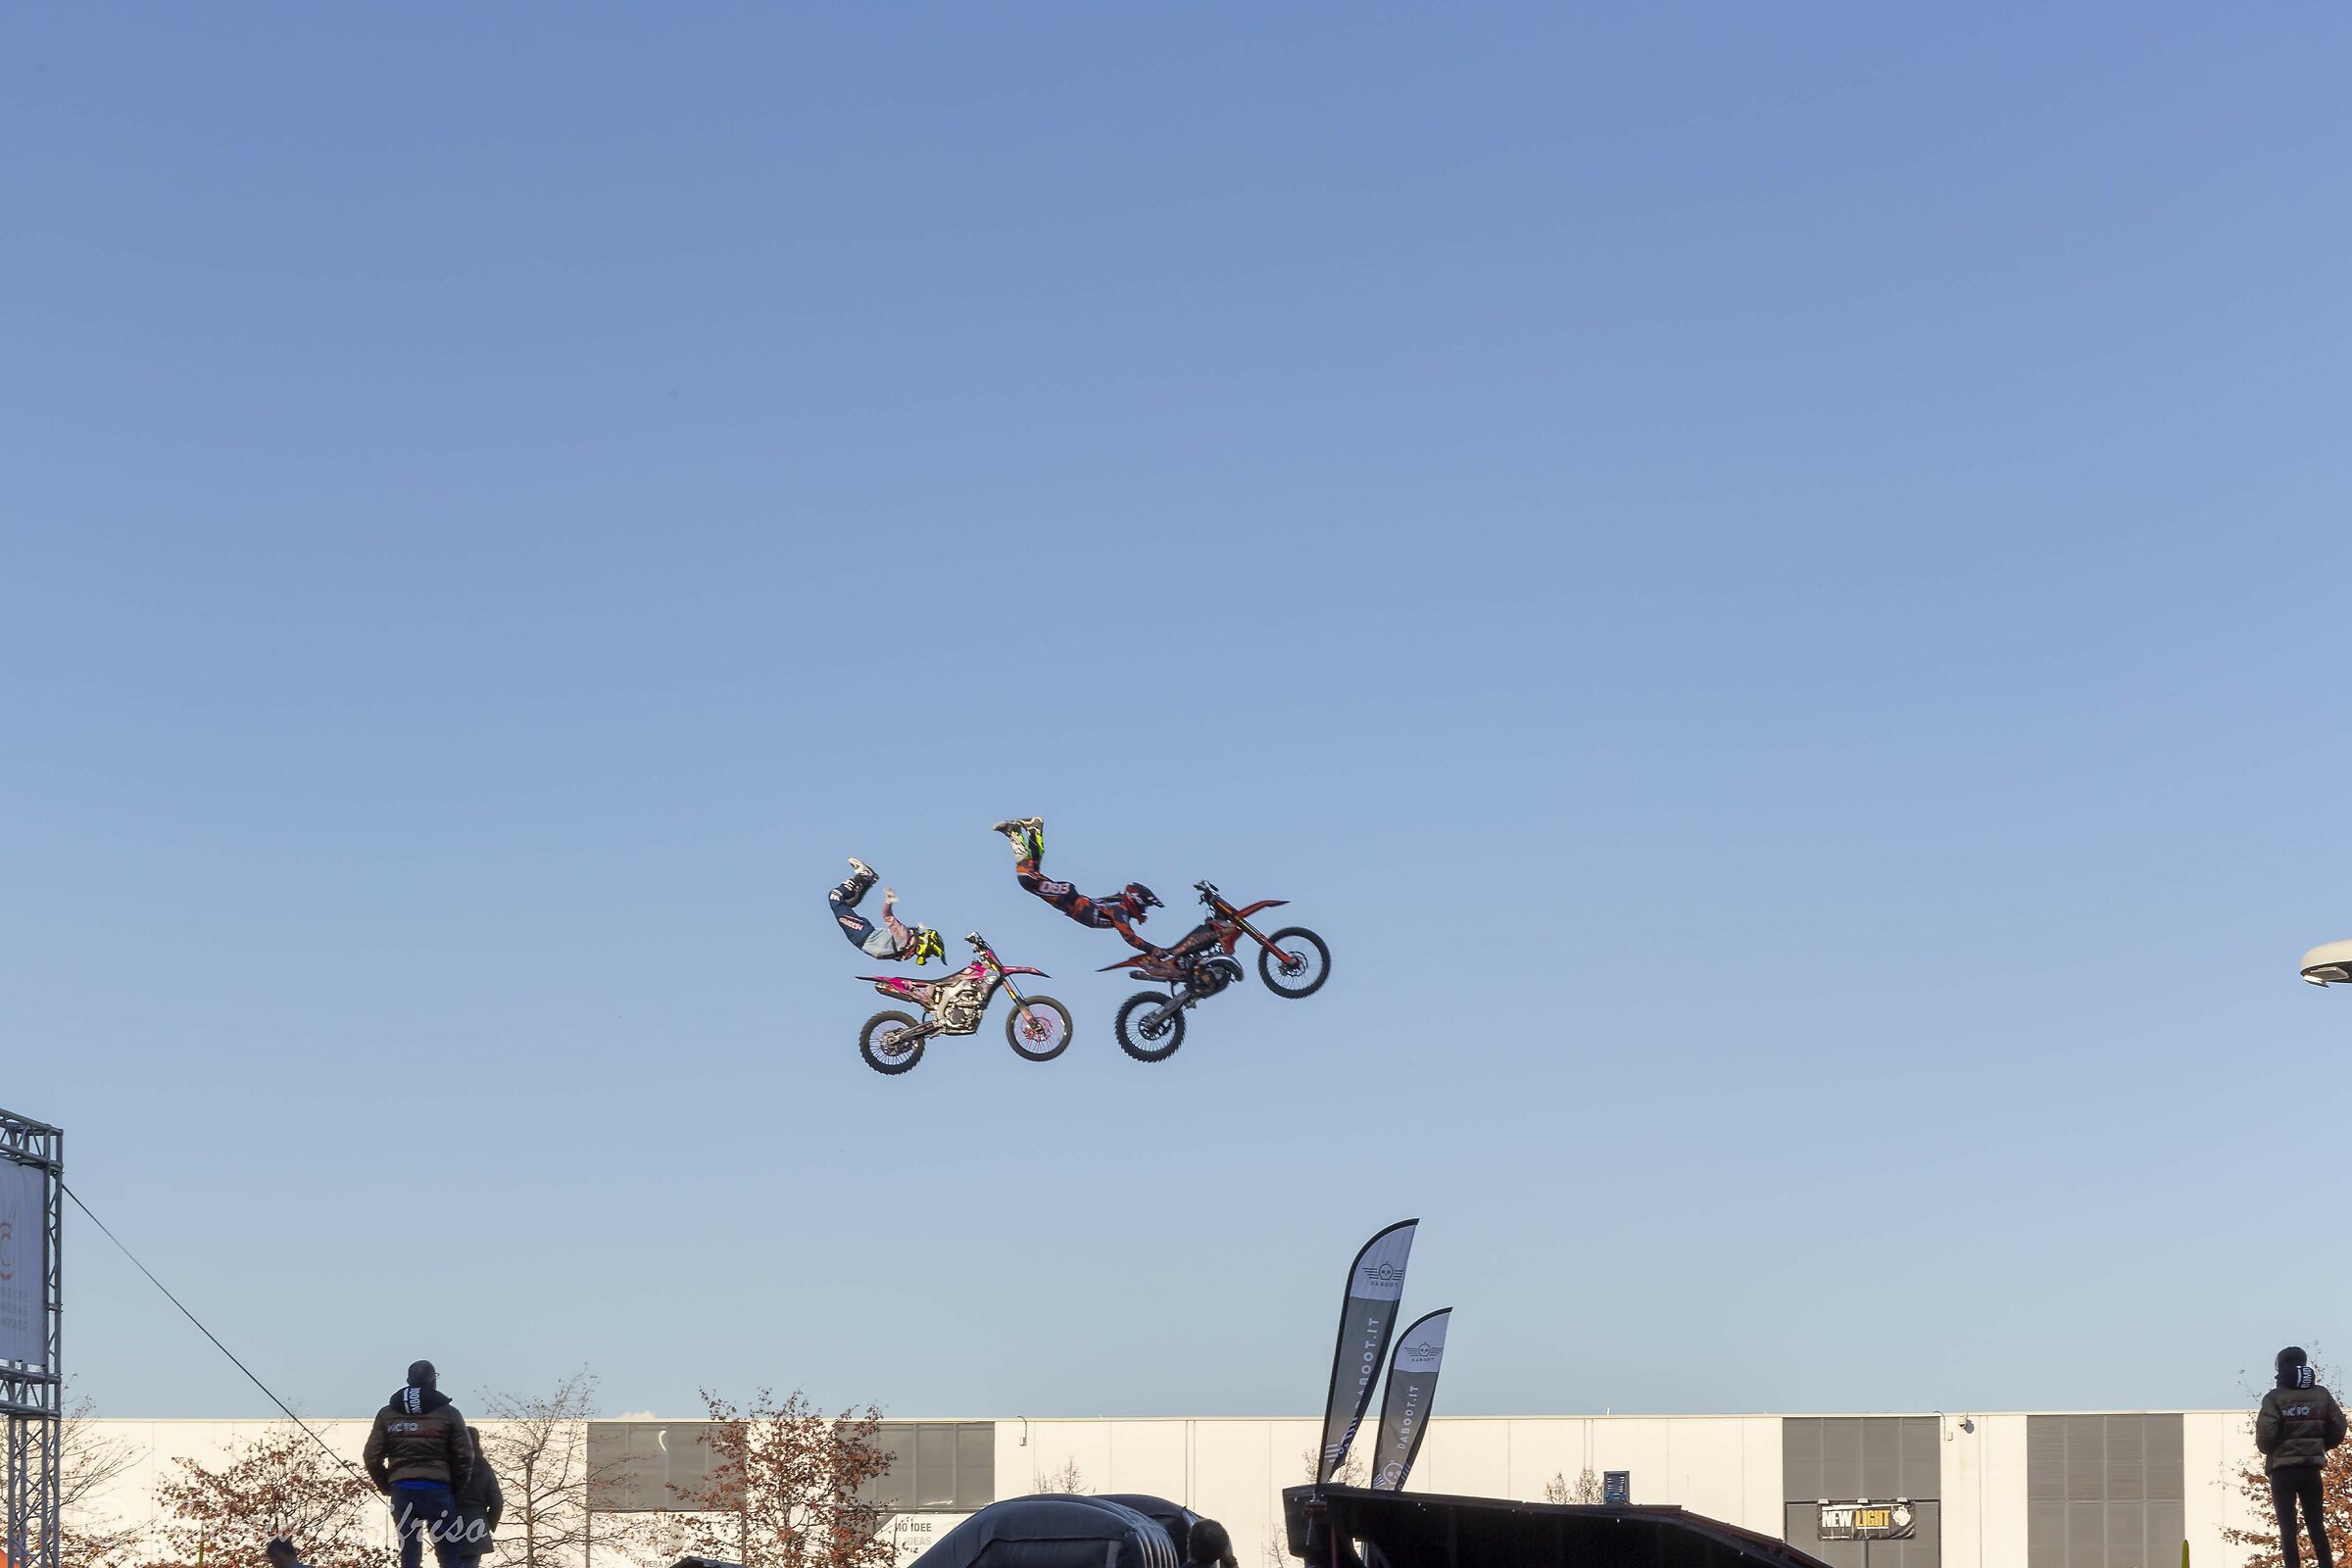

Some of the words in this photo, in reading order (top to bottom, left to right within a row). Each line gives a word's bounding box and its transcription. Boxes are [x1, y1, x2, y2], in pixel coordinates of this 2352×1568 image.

[1396, 1385, 1419, 1450] DABOOT.IT
[1822, 1510, 1853, 1527] NEW
[1855, 1510, 1890, 1527] LIGHT
[910, 1523, 932, 1532] IDEE
